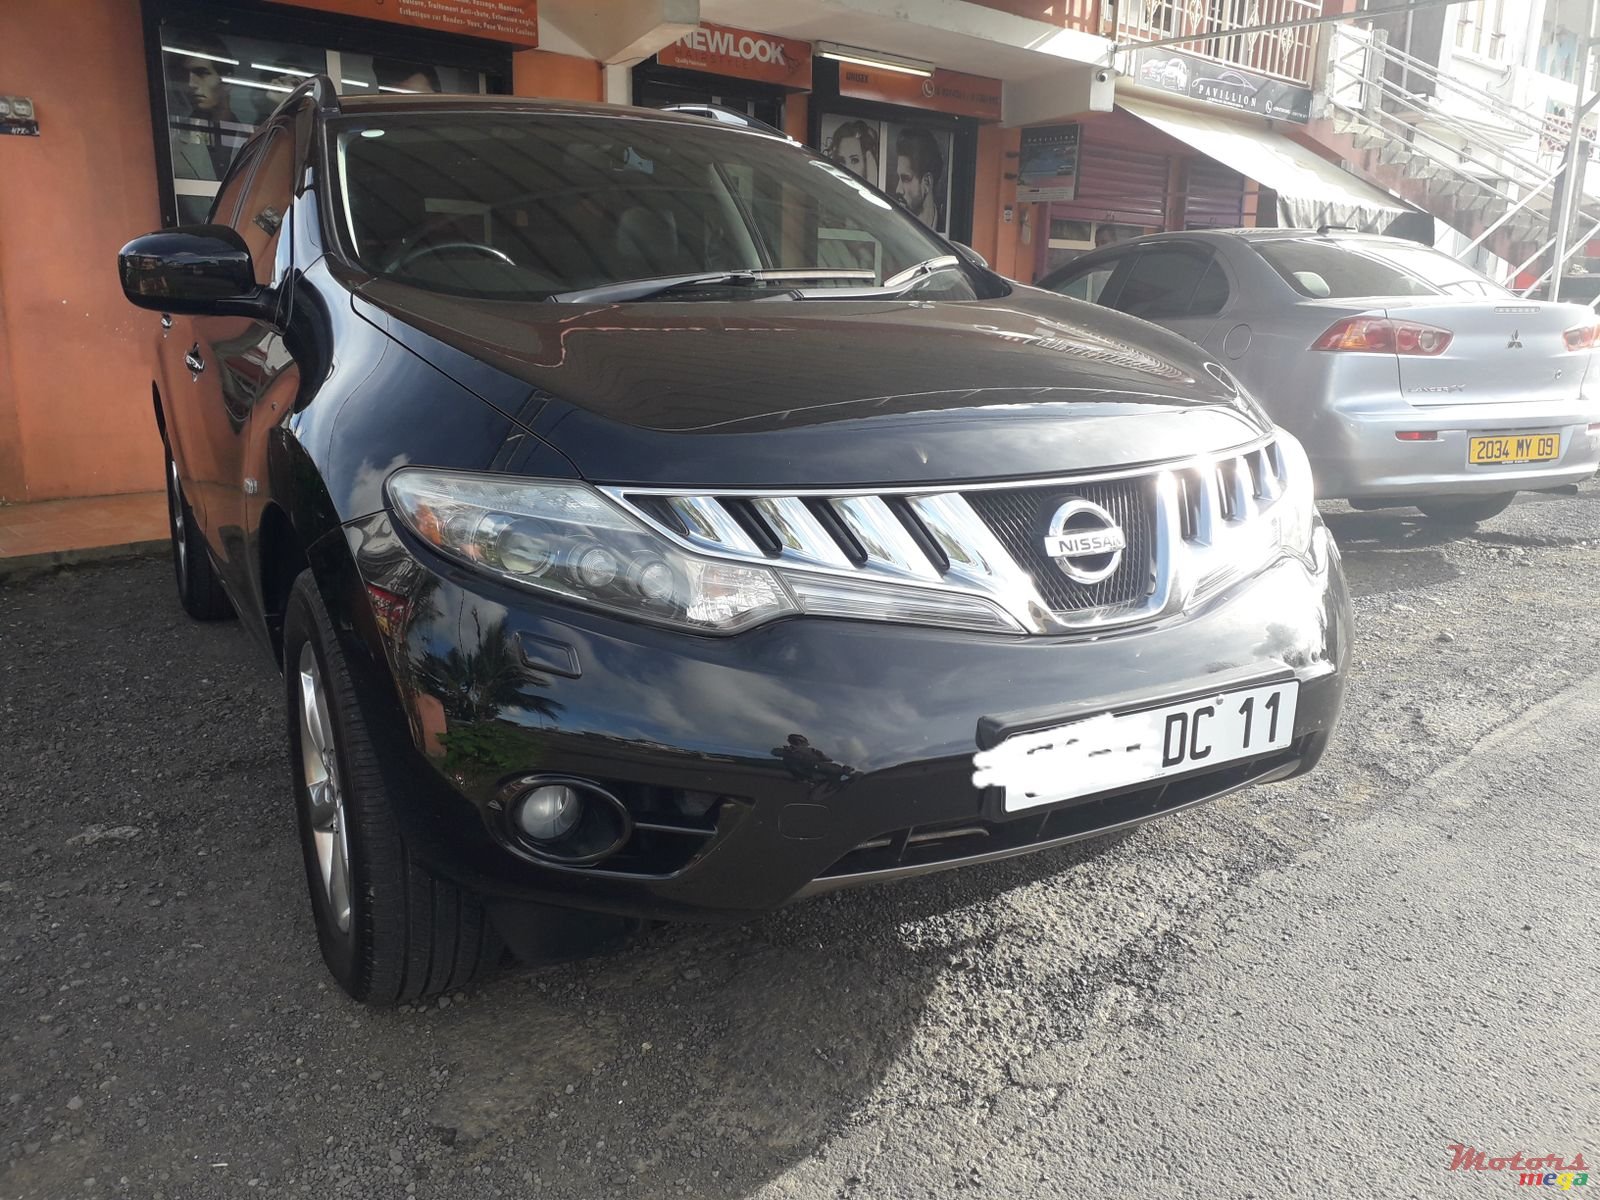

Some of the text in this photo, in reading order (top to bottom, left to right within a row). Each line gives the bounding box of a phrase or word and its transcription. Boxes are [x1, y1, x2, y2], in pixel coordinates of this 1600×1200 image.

[676, 28, 786, 66] NEWLOOK
[1198, 84, 1258, 107] PAVILLION
[1477, 438, 1553, 460] 2034 MY 09
[1058, 536, 1121, 552] NISSAN
[1162, 706, 1215, 768] DC
[1239, 691, 1281, 749] 11
